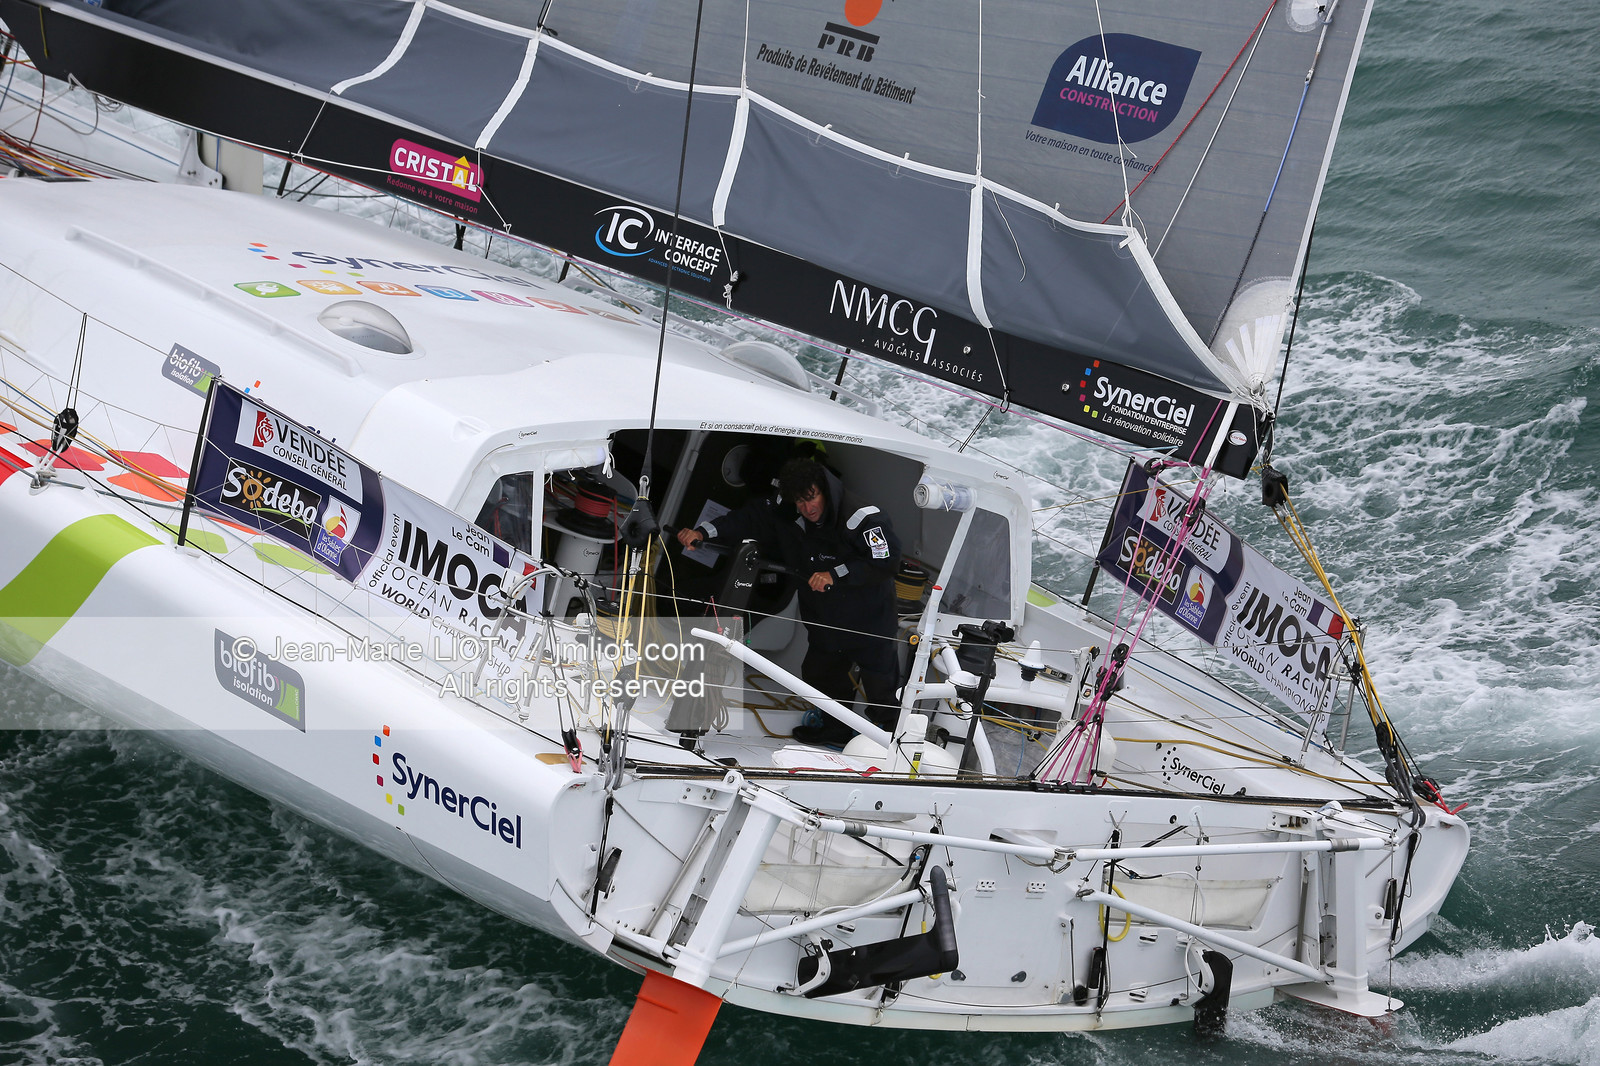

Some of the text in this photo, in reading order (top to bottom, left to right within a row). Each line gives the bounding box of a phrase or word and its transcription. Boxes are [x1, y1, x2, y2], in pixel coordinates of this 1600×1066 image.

[817, 33, 875, 62] PRB
[756, 43, 917, 104] Produits de Revêtement du Bâtiment
[1065, 55, 1167, 106] Alliance
[1059, 87, 1159, 123] CONSTRUCTION
[394, 147, 477, 192] CRISTAL
[1025, 130, 1047, 145] Votre
[1047, 136, 1078, 153] maison
[1078, 145, 1090, 156] en
[1090, 147, 1113, 163] toute
[1113, 155, 1153, 172] confiance
[386, 175, 416, 193] Redonne
[417, 185, 427, 196] vie
[435, 191, 453, 205] votre
[454, 200, 478, 214] maison
[605, 212, 644, 250] IC
[291, 250, 546, 291] SynerCiel
[664, 249, 718, 276] CONCEPT
[170, 349, 202, 377] biofib
[170, 368, 194, 386] isolation
[874, 339, 983, 382] AVOCATS ASSOCIÉS
[1093, 376, 1196, 427] SynerCiel
[1110, 405, 1188, 436] FONDATION D'ENTREPRISE
[274, 418, 347, 478] VENDÉE
[723, 423, 755, 431] consacrait
[754, 424, 767, 432] plus
[769, 425, 796, 436] d'énergie
[811, 431, 845, 441] consommer
[844, 435, 863, 444] moins
[1102, 413, 1184, 447] La rénovation solidaire
[272, 445, 348, 491] CONSEIL GÉNÉRAL
[223, 466, 318, 524] Sodebo
[451, 527, 490, 557] Le Cam
[465, 524, 490, 545] Jean
[1167, 496, 1221, 551] VDÉE
[368, 513, 401, 588] official event
[1184, 534, 1212, 561] ÉNÉRAL
[391, 566, 453, 612] OCEAN
[398, 520, 528, 642] IMOCA
[1231, 581, 1252, 611] event
[1293, 586, 1312, 605] Jean
[381, 583, 431, 620] WORLD
[1289, 598, 1308, 617] Cam
[459, 607, 519, 659] RACNG
[1236, 586, 1331, 693] IMOCA
[1231, 642, 1265, 674] WORLD
[233, 675, 273, 707] isolation
[1170, 757, 1226, 795] SynerCiel
[392, 752, 522, 850] SynerCiel
